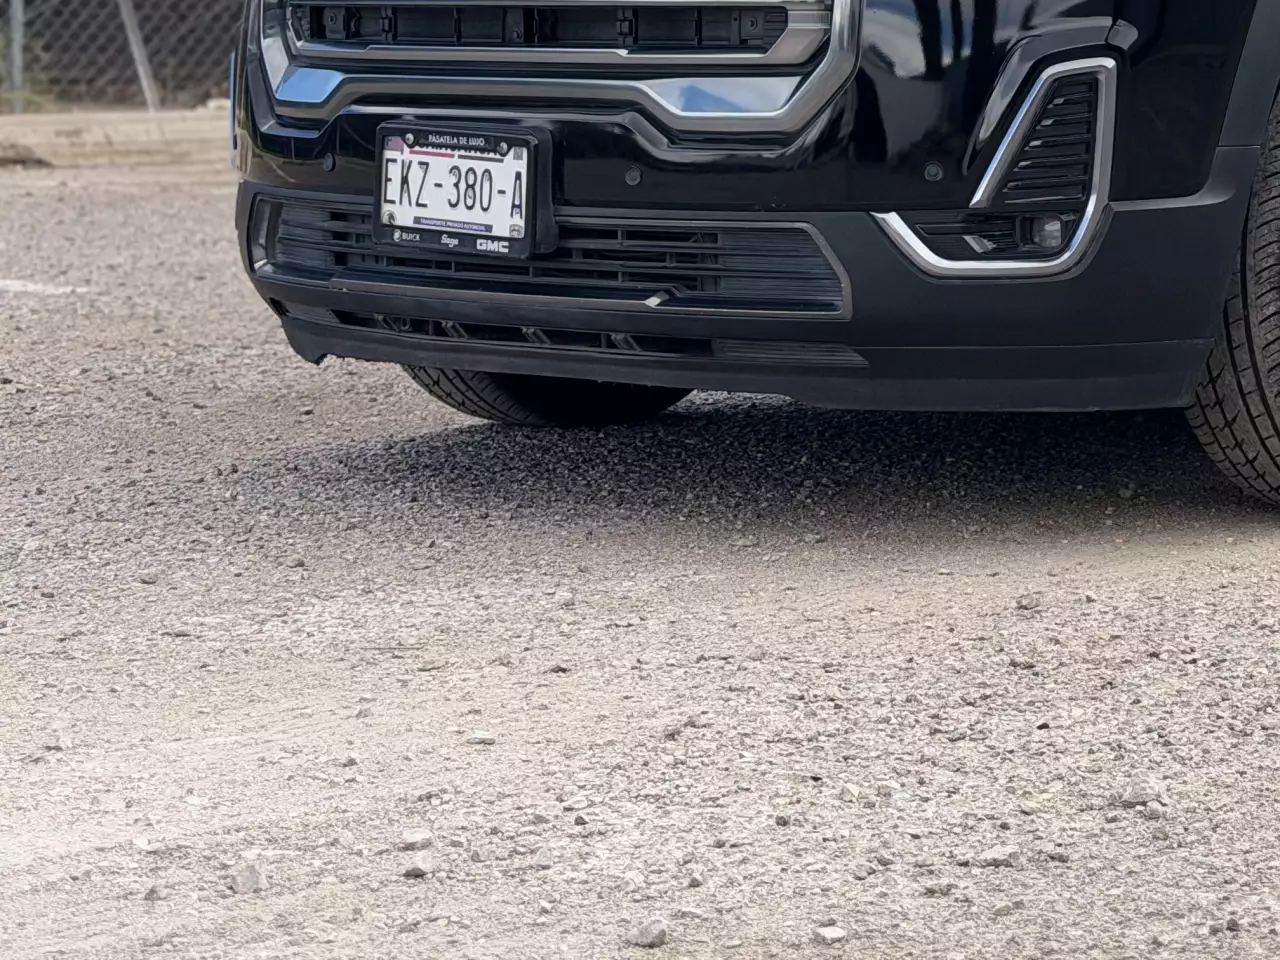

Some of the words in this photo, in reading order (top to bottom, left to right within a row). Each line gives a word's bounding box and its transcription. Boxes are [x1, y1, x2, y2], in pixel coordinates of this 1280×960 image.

[460, 136, 468, 145] DE
[469, 137, 486, 146] LUJO
[383, 157, 523, 220] EKZ-380-A
[402, 232, 420, 241] BUICK
[476, 239, 509, 253] GMC
